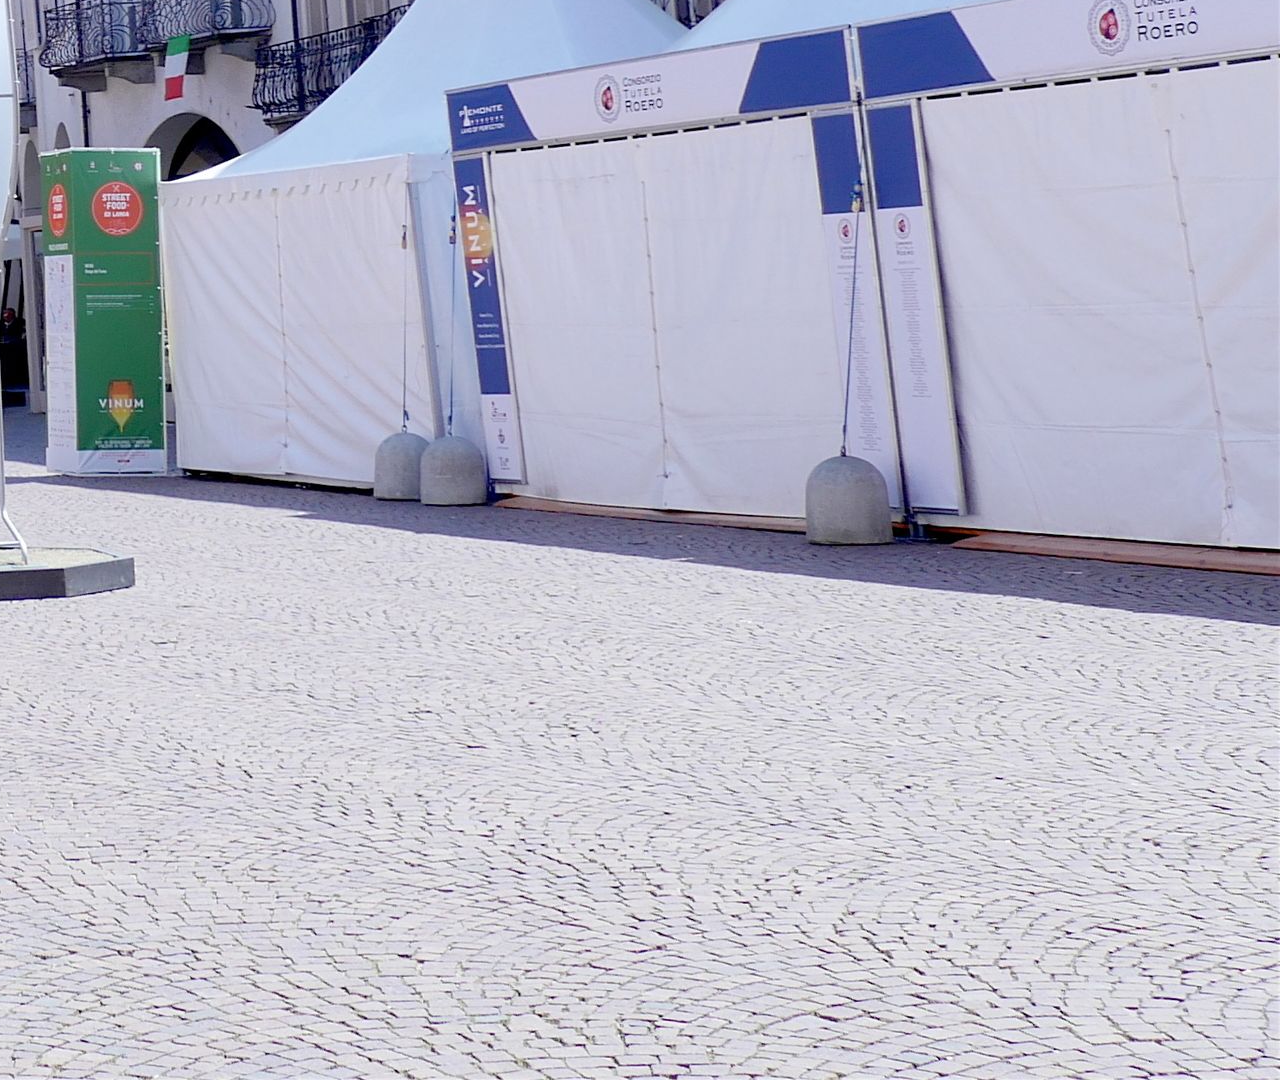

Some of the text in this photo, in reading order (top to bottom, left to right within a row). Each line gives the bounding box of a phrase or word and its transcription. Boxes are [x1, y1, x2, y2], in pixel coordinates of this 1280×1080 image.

[1134, 6, 1197, 23] TUTELA
[1137, 21, 1199, 41] ROERO
[622, 74, 661, 87] CONSORZIO
[623, 87, 662, 99] TUTELA
[459, 104, 503, 118] PIEMONTE
[625, 98, 663, 113] ROERO
[101, 193, 131, 202] STREET
[106, 202, 127, 210] FOOD
[462, 185, 486, 288] VINUM
[99, 398, 144, 408] VINUM
